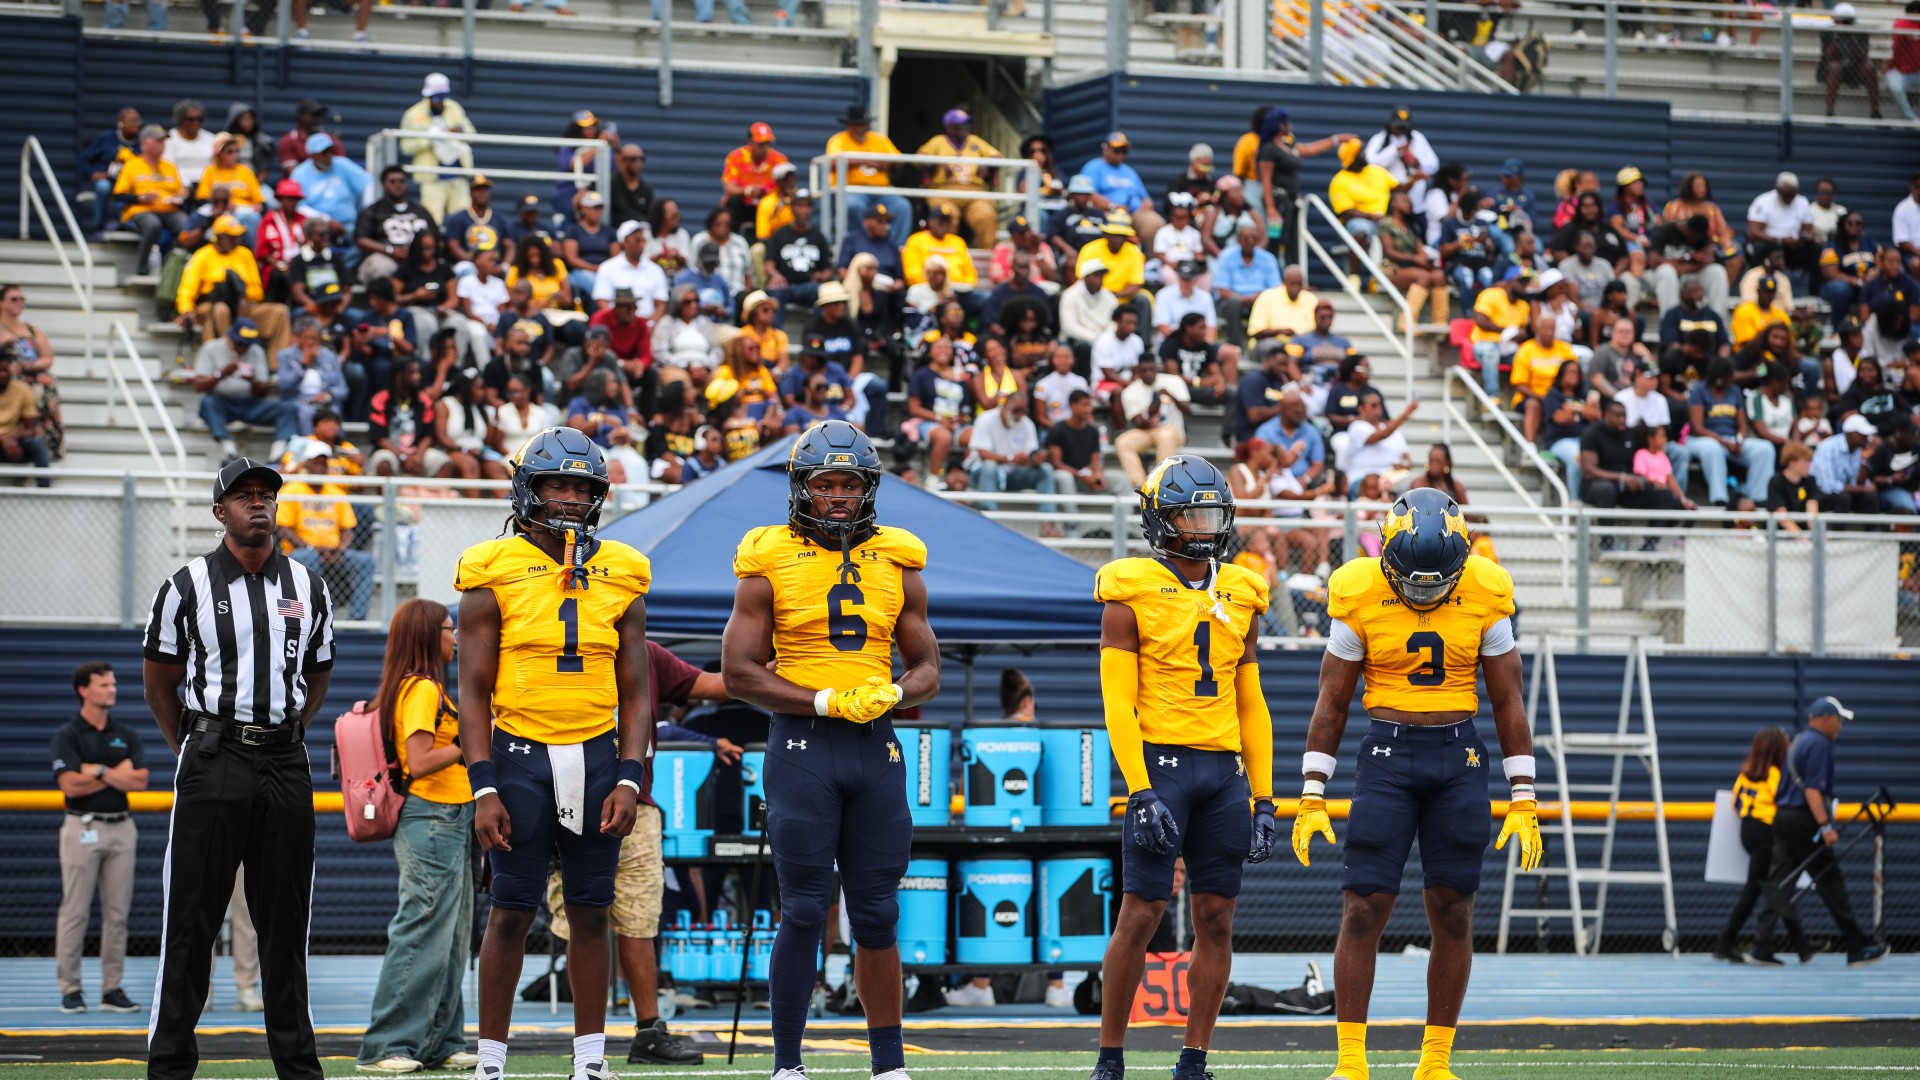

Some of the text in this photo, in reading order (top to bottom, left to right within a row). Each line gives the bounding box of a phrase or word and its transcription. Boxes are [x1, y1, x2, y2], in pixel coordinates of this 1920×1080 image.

[571, 461, 586, 469] JCSU
[1202, 492, 1215, 500] JCSU
[798, 551, 817, 559] CIAA
[528, 565, 547, 573] CIAA
[217, 600, 230, 615] S
[1382, 598, 1401, 606] CIAA
[827, 584, 868, 651] 6
[557, 598, 583, 672] 1
[286, 639, 298, 658] S
[1193, 621, 1218, 697] 1
[1406, 631, 1446, 686] 3
[1142, 962, 1190, 1016] 50
